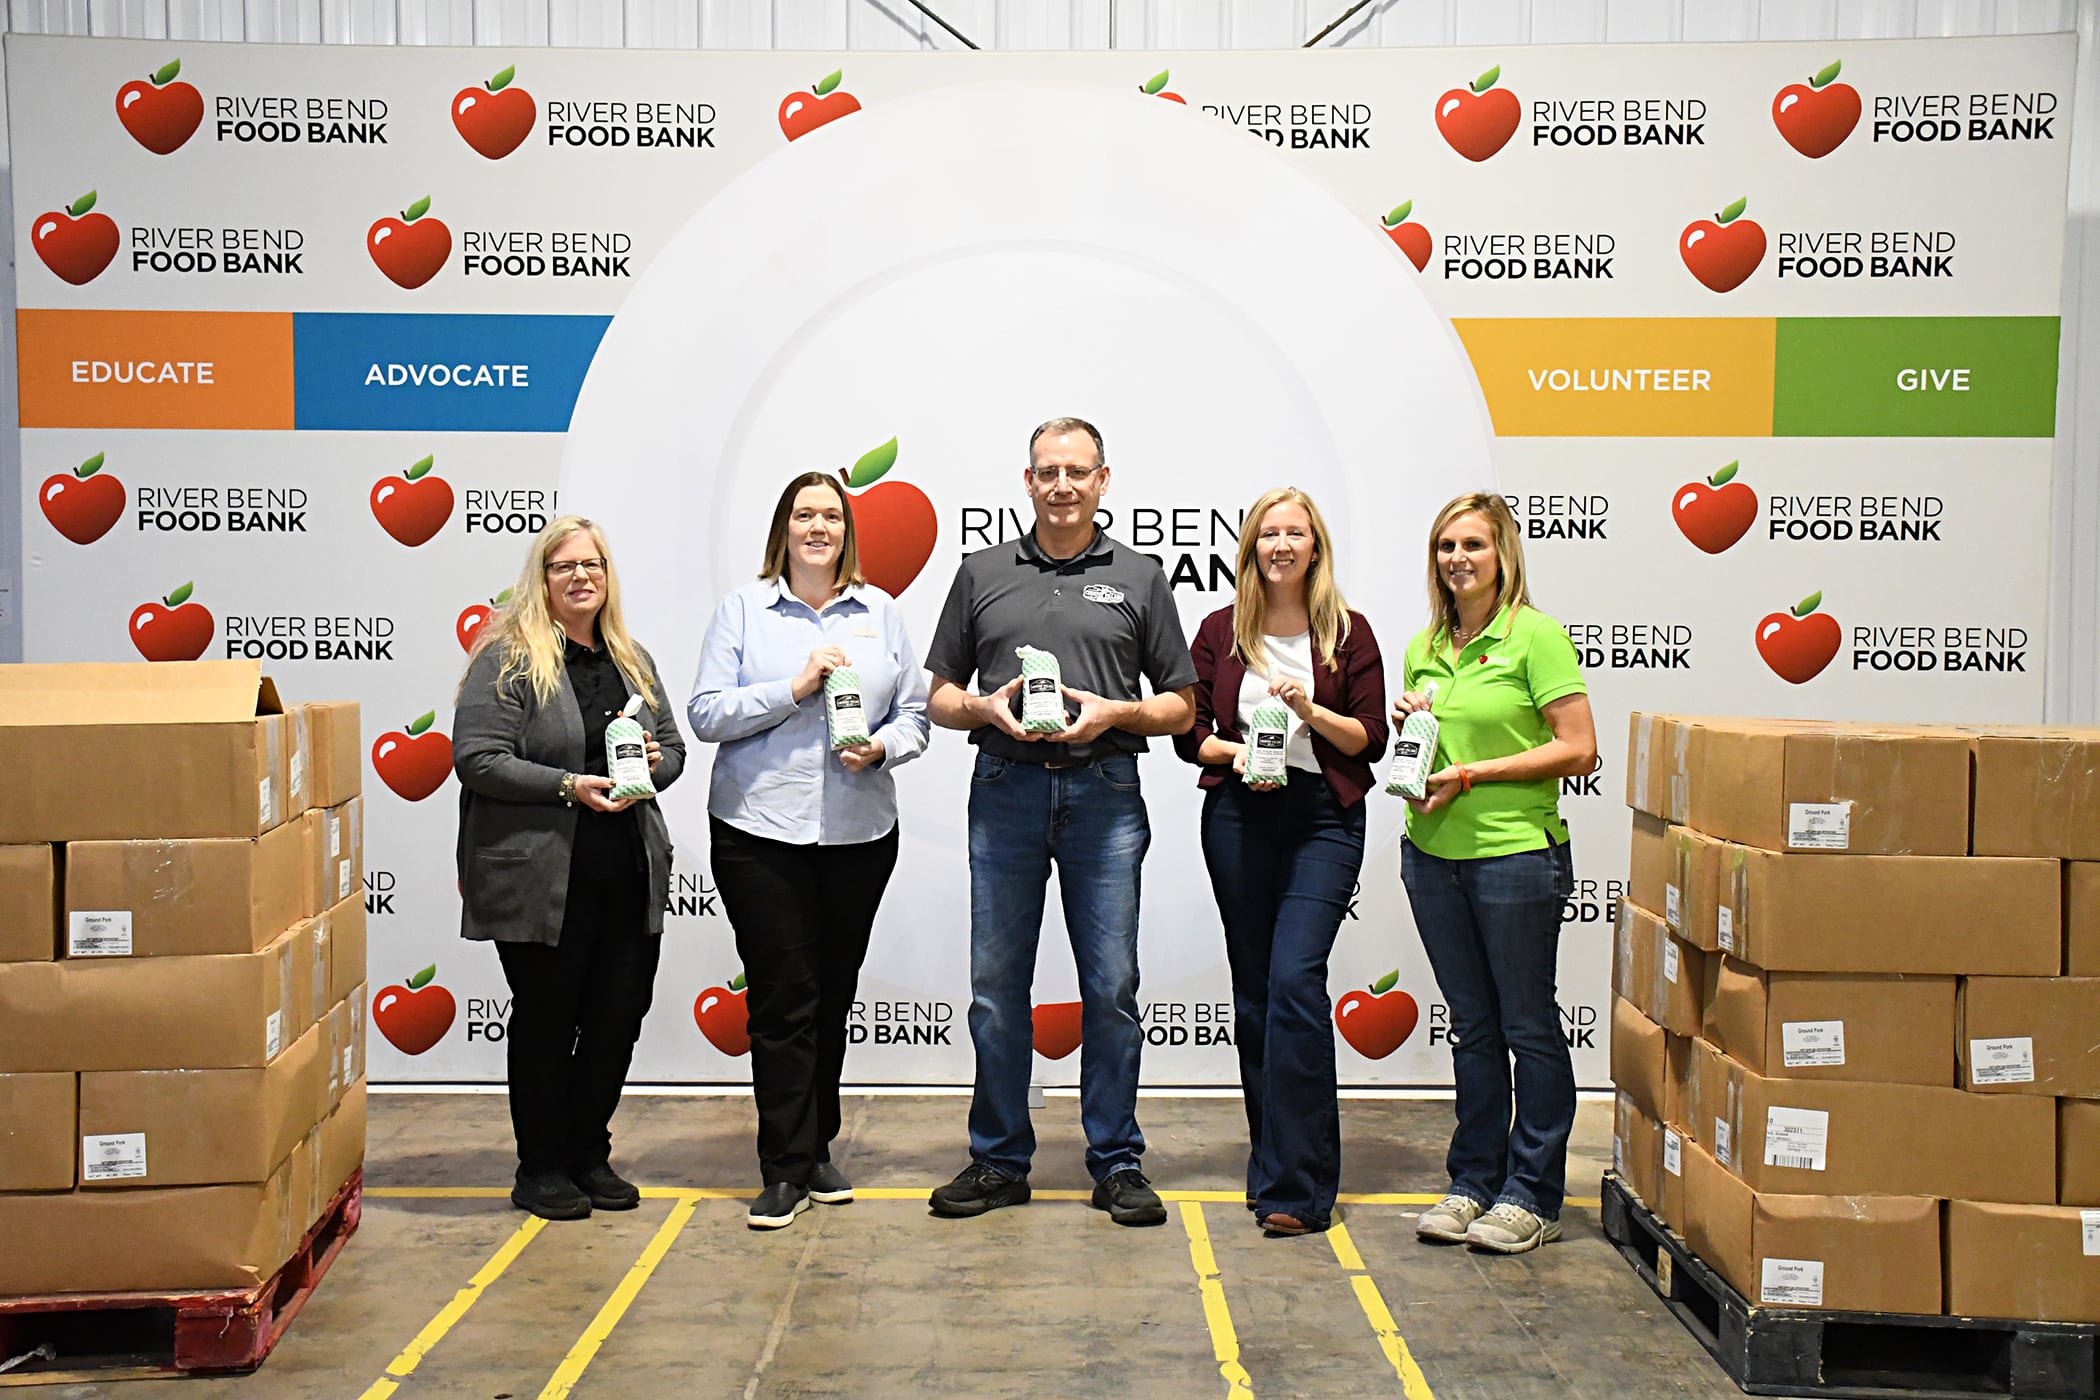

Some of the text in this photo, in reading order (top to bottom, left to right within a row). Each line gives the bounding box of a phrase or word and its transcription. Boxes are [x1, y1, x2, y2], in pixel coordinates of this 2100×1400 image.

[216, 97, 388, 120] RIVER BEND
[549, 102, 715, 124] RIVER BEND
[1292, 104, 1370, 125] BEND
[1534, 100, 1706, 122] RIVER BEND
[1875, 93, 2057, 118] RIVER BEND
[217, 120, 388, 144] FOOD BANK
[549, 126, 715, 148] FOOD BANK
[1292, 128, 1370, 148] BANK
[1534, 124, 1704, 146] FOOD BANK
[1874, 117, 2054, 142] FOOD BANK
[132, 228, 303, 250] RIVER BEND
[464, 232, 630, 253] RIVER BEND
[1445, 234, 1614, 255] RIVER BEND
[1779, 232, 1955, 254] RIVER BEND
[133, 251, 303, 274] FOOD BANK
[465, 256, 630, 276] FOOD BANK
[1445, 258, 1613, 279] FOOD BANK
[1779, 256, 1953, 278] FOOD BANK
[73, 362, 214, 384] EDUCATE
[365, 364, 529, 387] ADVOCATE
[1528, 369, 1711, 391] VOLUNTEER
[1897, 369, 1971, 391] GIVE
[138, 488, 307, 508] RIVER BEND
[466, 490, 545, 510] RIVER
[1529, 495, 1609, 516] BEND
[1770, 496, 1943, 517] RIVER BEND
[139, 511, 306, 532] FOOD BANK
[466, 513, 547, 533] FOOD
[1133, 508, 1244, 546] BEN
[1528, 519, 1608, 539] BANK
[1770, 520, 1941, 541] FOOD BANK
[1149, 553, 1238, 592] AN
[227, 617, 394, 637] RIVER BEND
[1612, 625, 1692, 645] BEND
[1854, 627, 2027, 648] RIVER BEND
[227, 640, 393, 660] FOOD BANK
[1612, 648, 1690, 668] BANK
[1853, 650, 2026, 672] FOOD BANK
[1562, 775, 1602, 796] NK
[363, 871, 396, 891] ND
[365, 894, 395, 914] NK
[664, 896, 717, 916] ANK
[1562, 902, 1600, 922] OD
[467, 999, 511, 1019] RIV
[875, 1002, 953, 1022] BEND
[1195, 1003, 1230, 1023] BE
[1558, 1006, 1597, 1026] ND
[467, 1022, 506, 1042] FO
[874, 1024, 952, 1045] BANK
[1141, 1026, 1233, 1046] OD BA
[1566, 1028, 1596, 1048] NK
